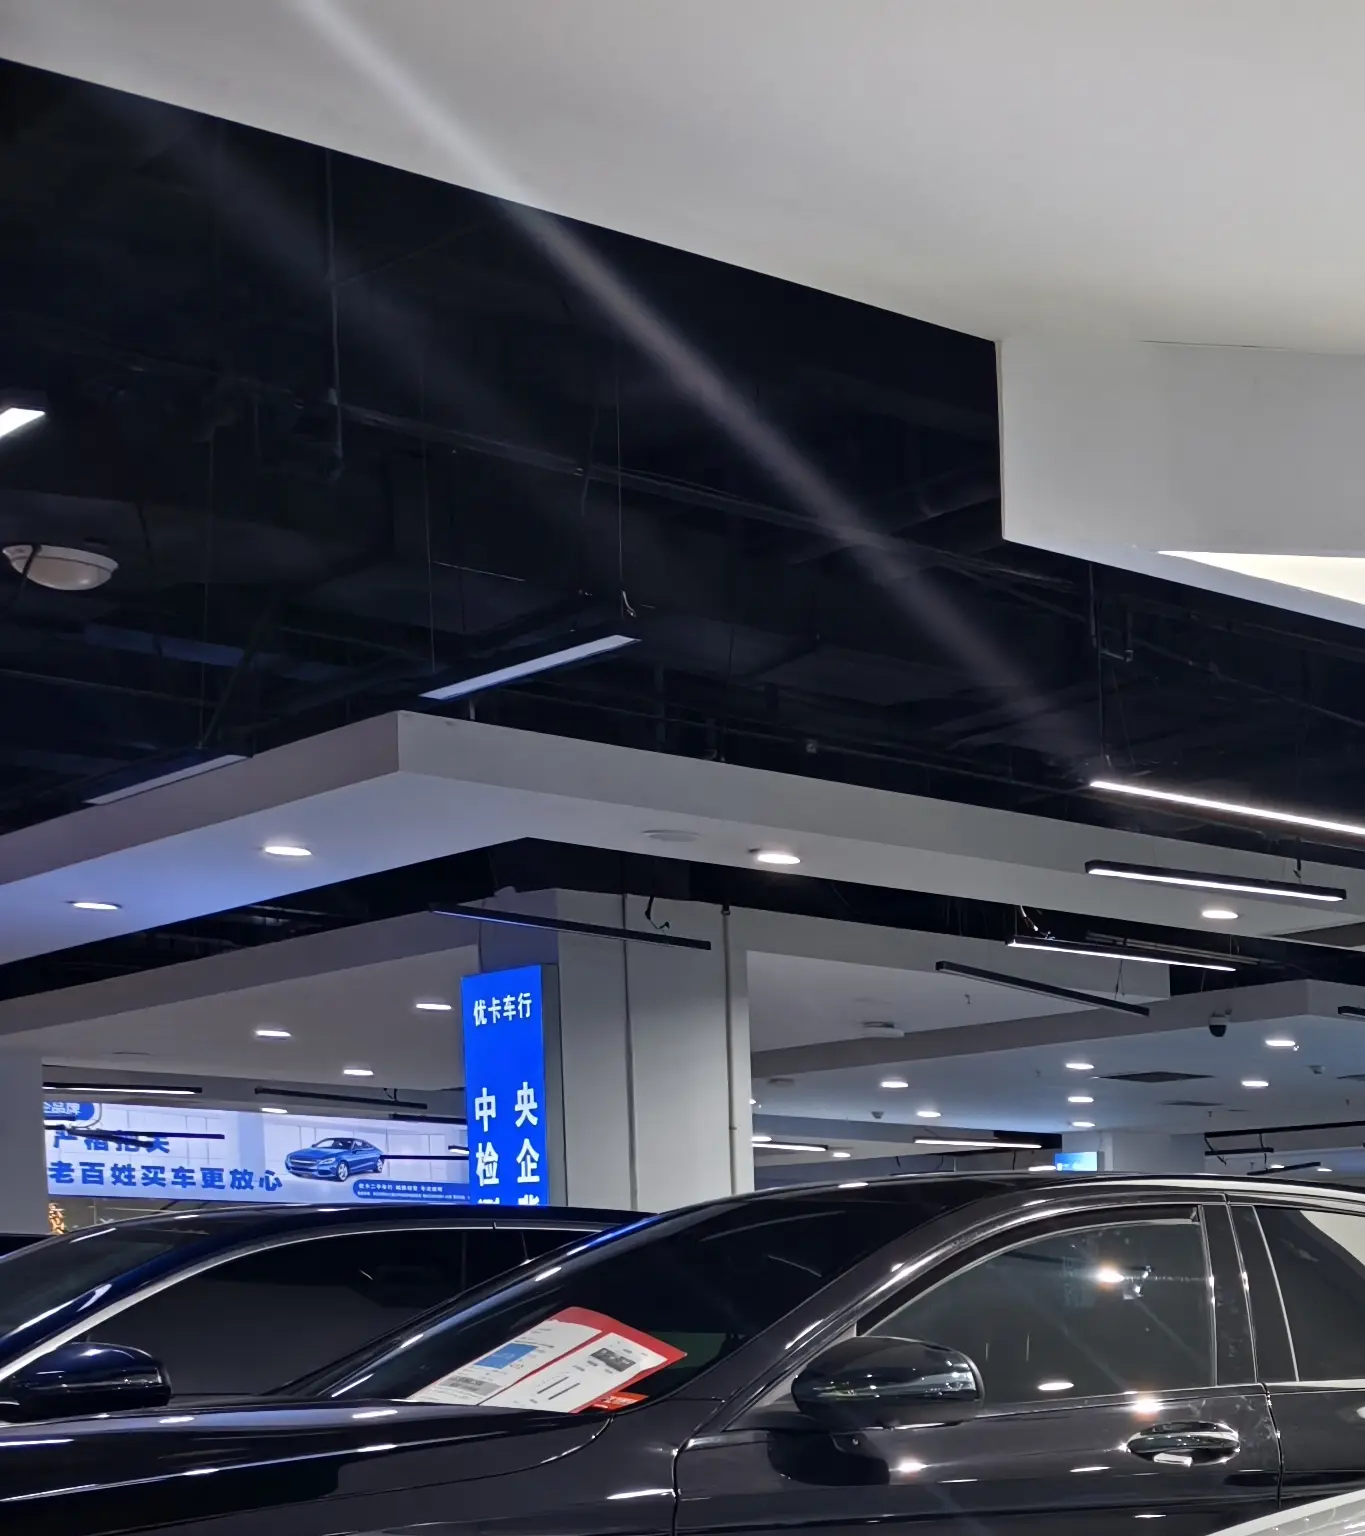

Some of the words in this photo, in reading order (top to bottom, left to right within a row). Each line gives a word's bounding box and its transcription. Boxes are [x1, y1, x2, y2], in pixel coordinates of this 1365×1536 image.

[473, 992, 532, 1026] 优卡车行
[474, 1087, 500, 1204] 中检
[48, 1161, 283, 1191] 老百姓买车更放心
